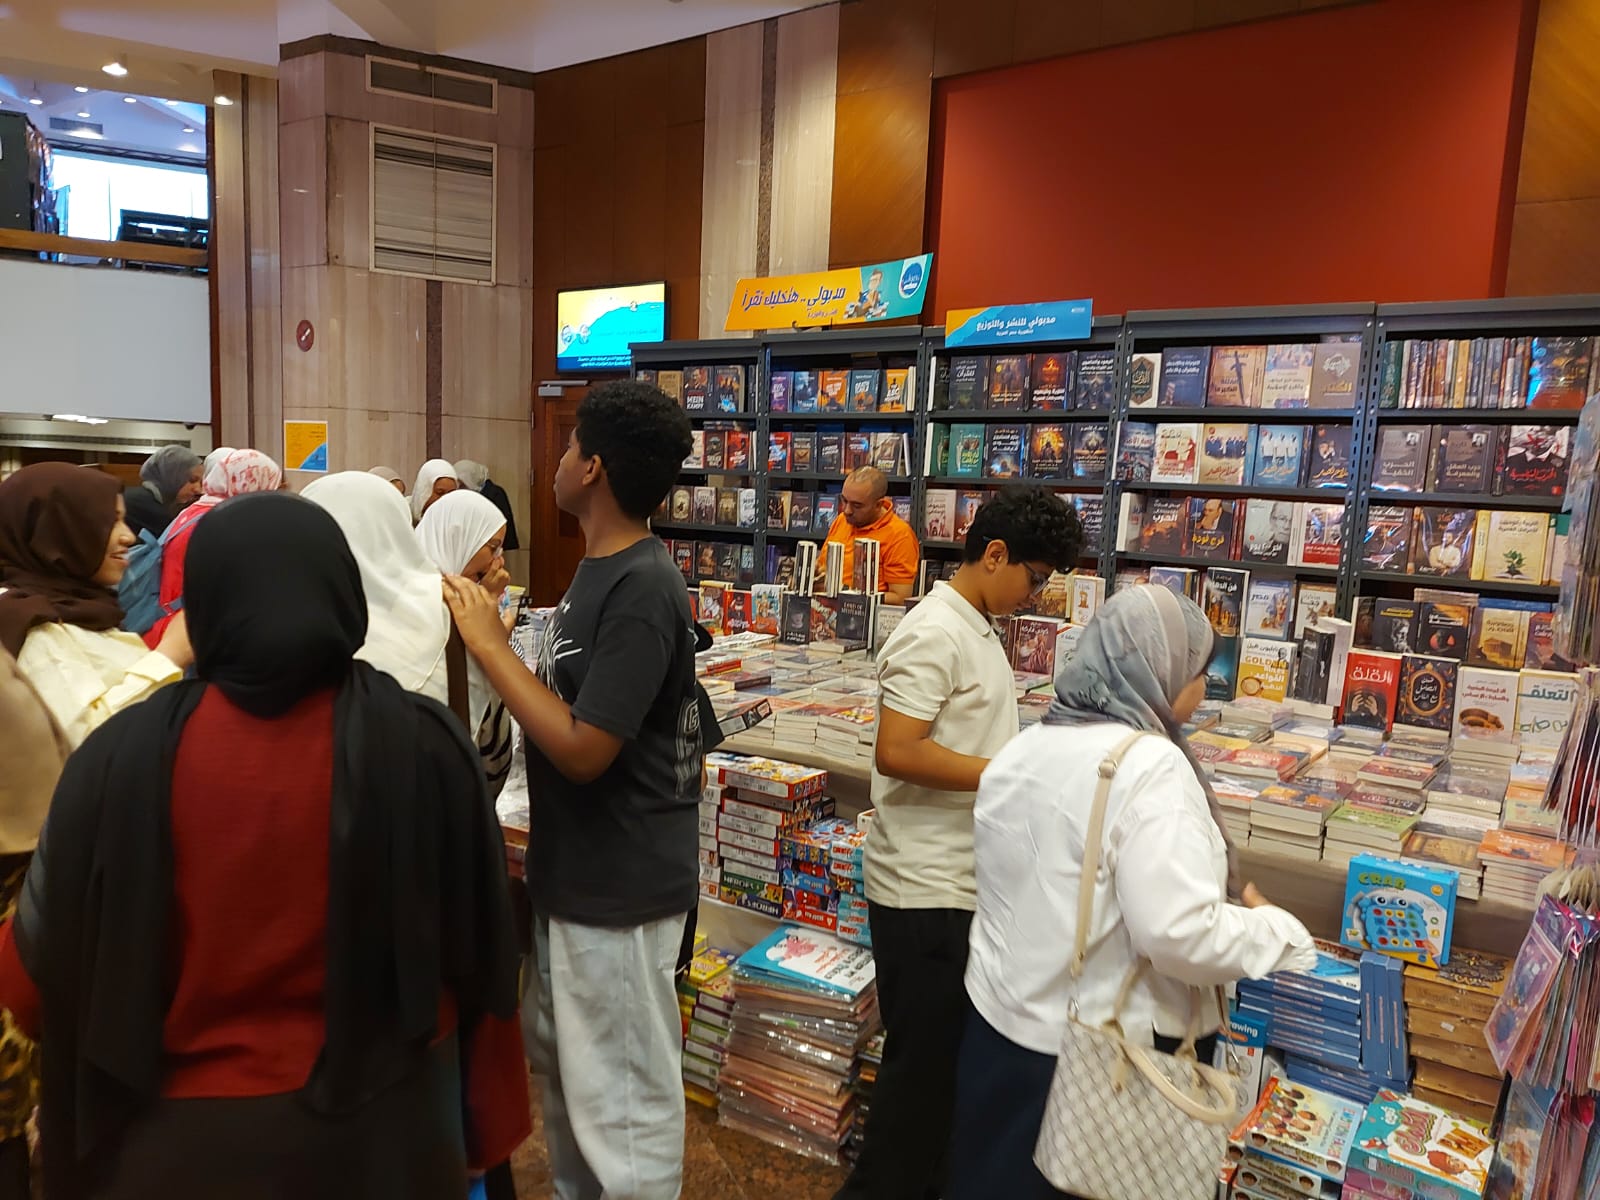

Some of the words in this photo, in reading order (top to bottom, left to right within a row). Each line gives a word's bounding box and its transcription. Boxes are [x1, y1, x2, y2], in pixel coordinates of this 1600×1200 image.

[976, 319, 1005, 332] والتوزيع
[1005, 316, 1027, 330] للنشر
[1028, 316, 1056, 329] مدبولي
[1210, 534, 1225, 548] فرج
[1358, 872, 1406, 891] CRAB
